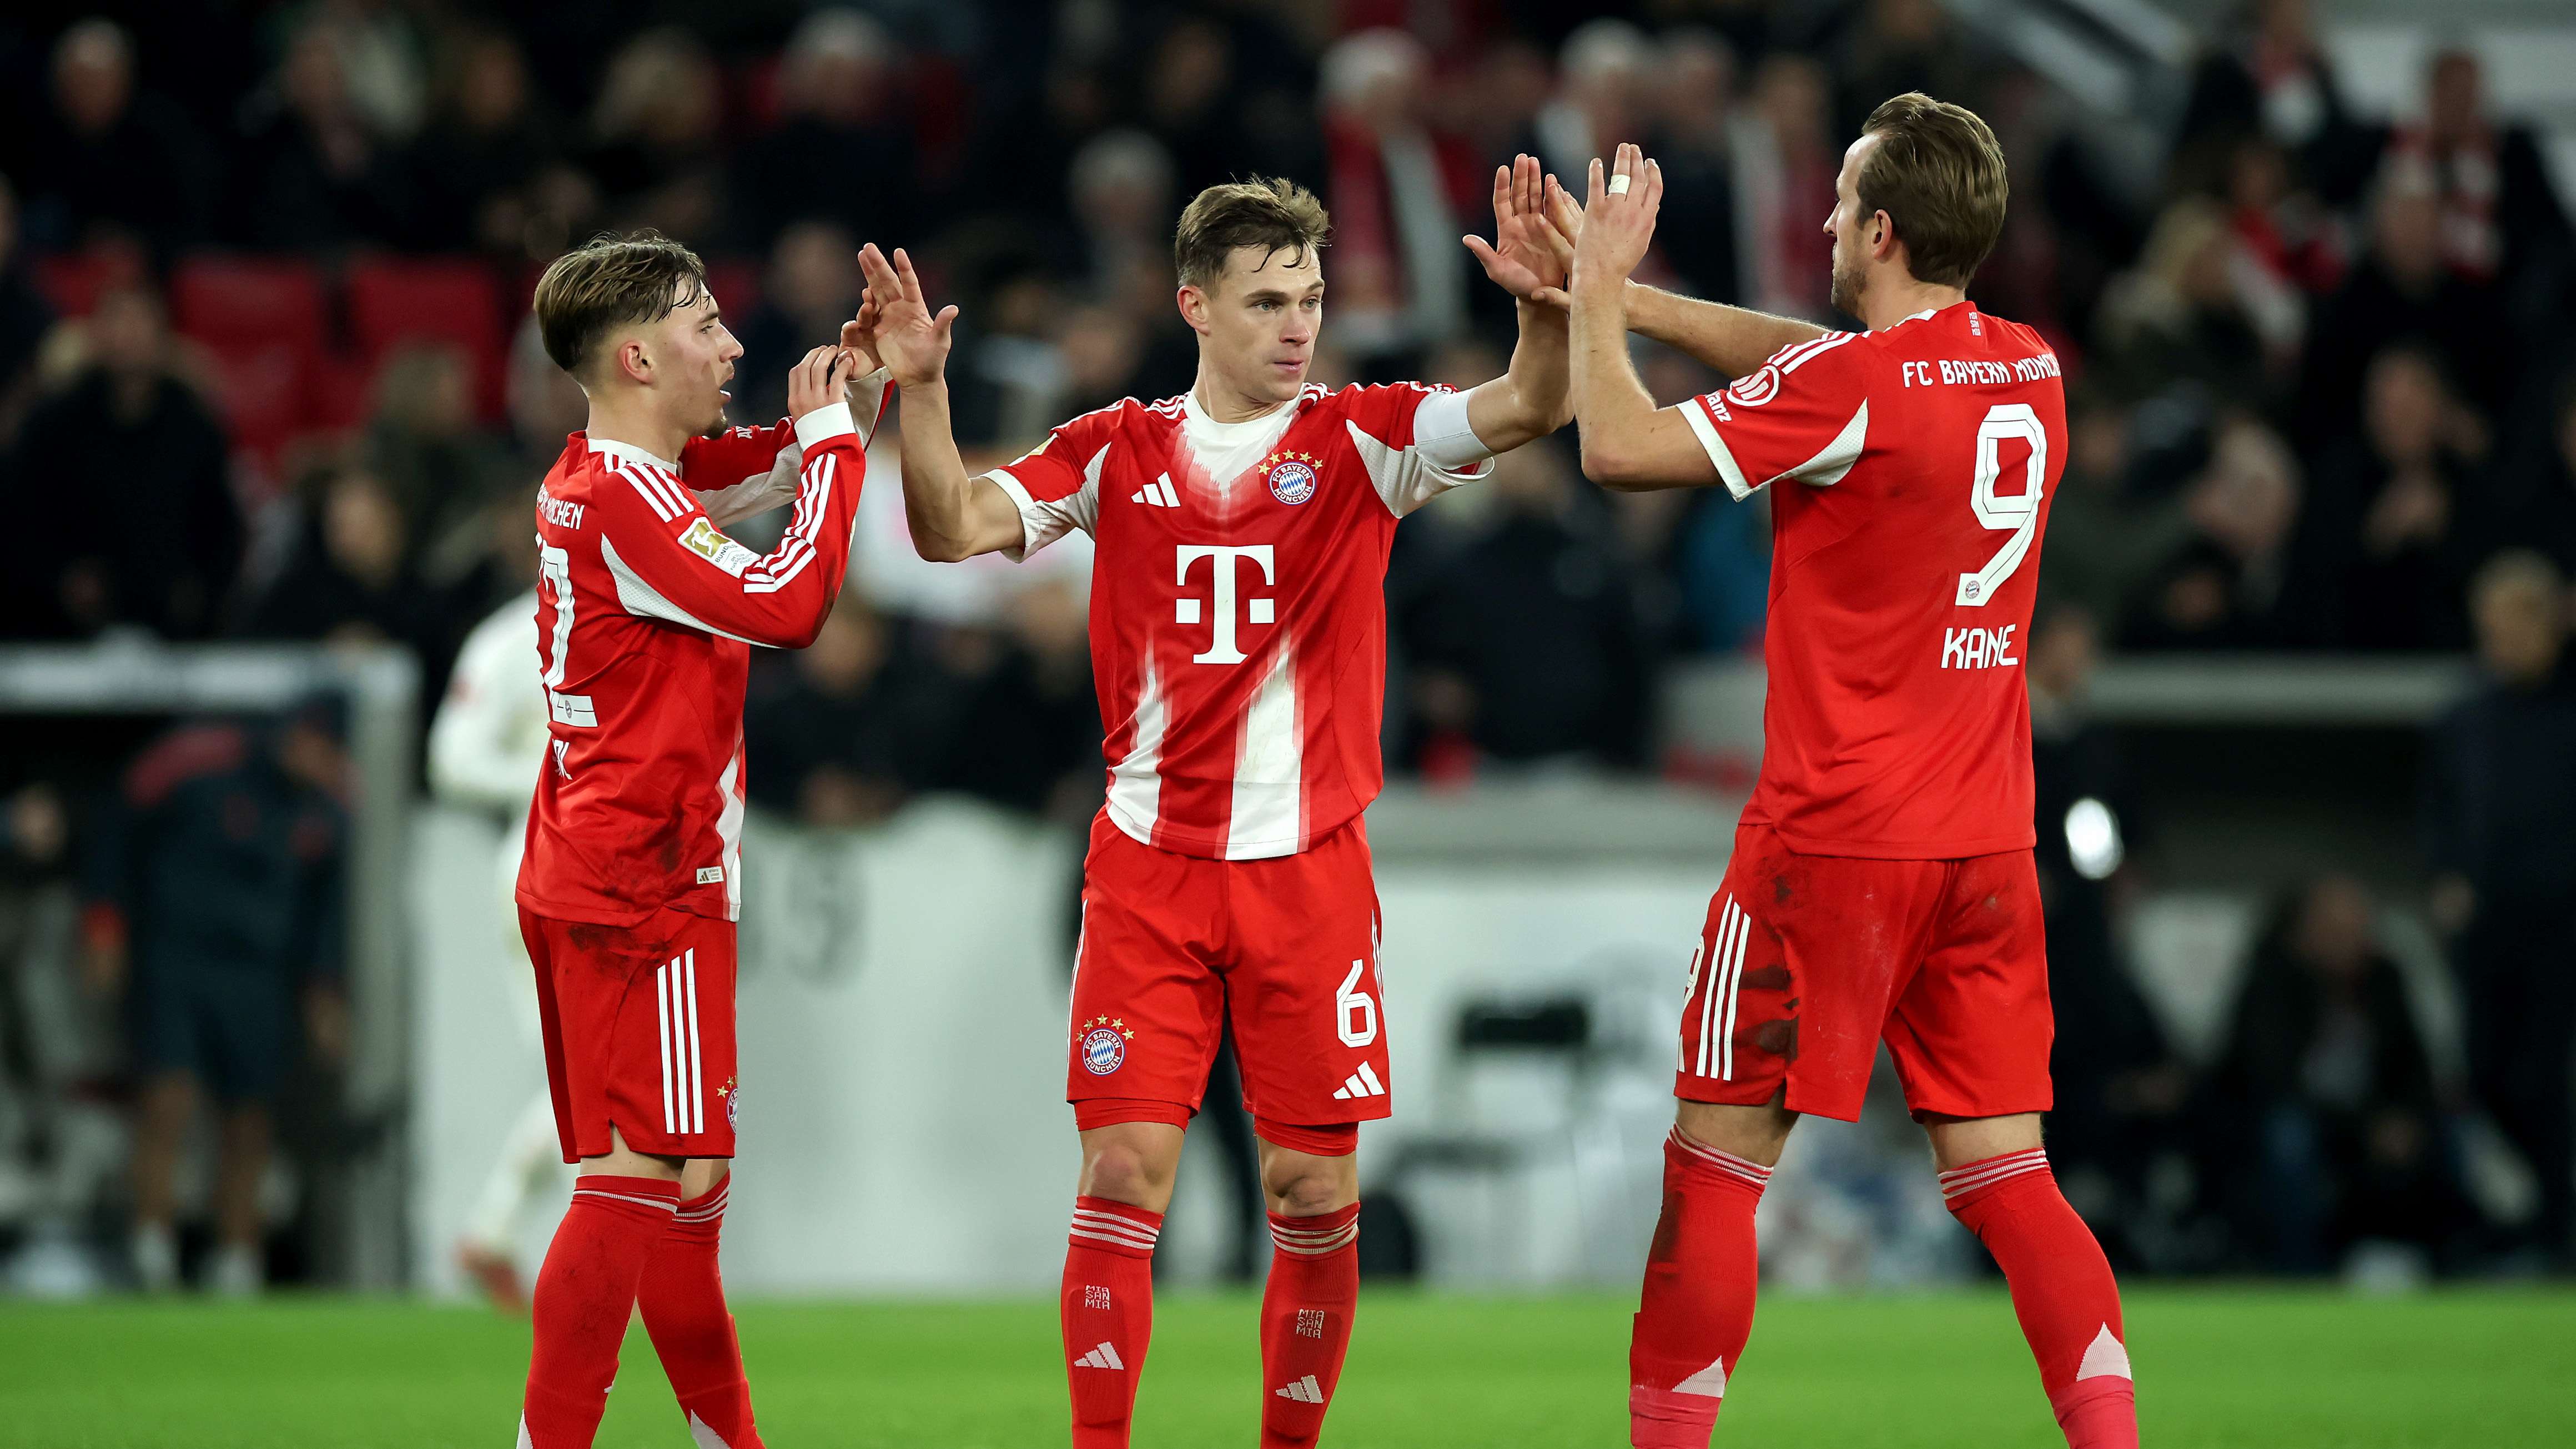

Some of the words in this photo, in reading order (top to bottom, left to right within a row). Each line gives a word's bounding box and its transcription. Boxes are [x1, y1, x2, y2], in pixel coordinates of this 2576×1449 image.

[1902, 361, 1933, 388] FC
[1938, 360, 2011, 385] BAYERN
[1272, 472, 1281, 482] FC
[1280, 465, 1311, 480] BAYERN
[1955, 403, 2047, 606] 9
[1941, 623, 2019, 669] KANE
[1336, 959, 1377, 1048] 6
[1085, 1039, 1093, 1050] FC
[1093, 1032, 1121, 1049] BAYERN
[1085, 1290, 1110, 1301] SAN
[1085, 1298, 1110, 1310] MIA
[1297, 1316, 1322, 1329] SAN
[1299, 1309, 1325, 1320] MIA
[1296, 1325, 1321, 1339] MIA
